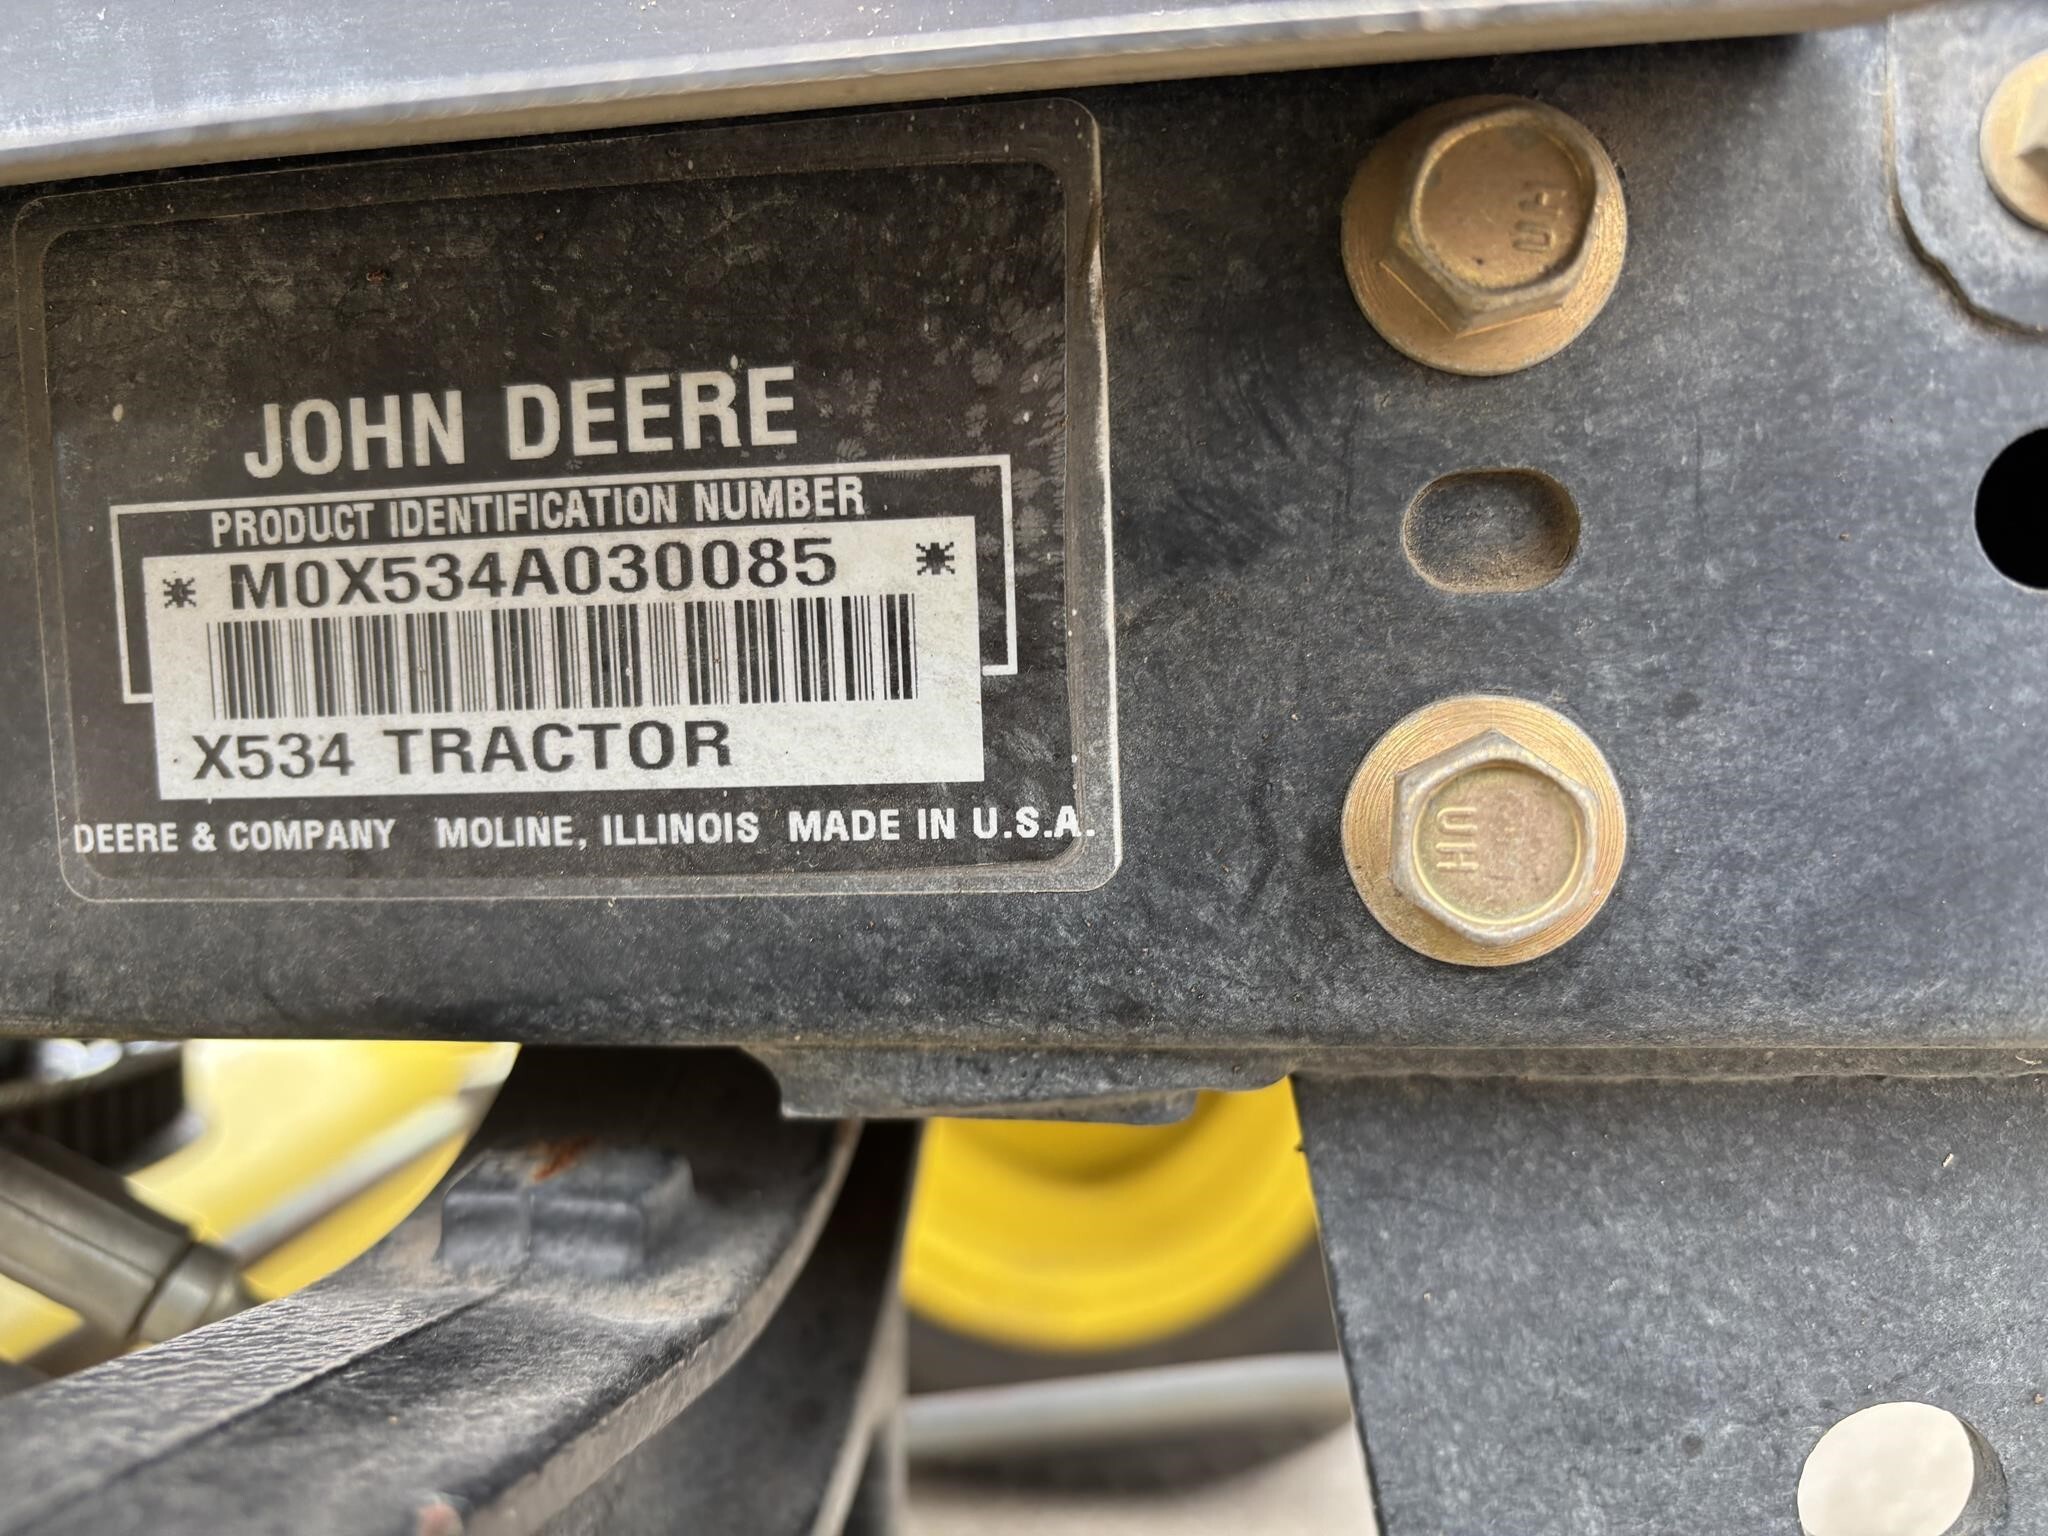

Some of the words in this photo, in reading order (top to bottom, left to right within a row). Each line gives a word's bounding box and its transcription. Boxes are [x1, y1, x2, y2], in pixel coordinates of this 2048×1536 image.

[244, 390, 466, 479] JOHN
[506, 366, 798, 461] DEERE
[211, 502, 374, 548] PRODUCT
[389, 484, 677, 538] IDENTIFICATION
[694, 475, 866, 523] NUMBER
[229, 537, 837, 610] M0X534A030085
[192, 731, 355, 780] X534
[383, 719, 731, 775] TRACTOR
[74, 822, 178, 854] DEERE
[192, 820, 217, 852] &
[229, 818, 397, 851] COMPANY
[434, 815, 588, 851] MOLINE,
[603, 811, 760, 846] ILLINOIS
[788, 808, 900, 843] MADE
[917, 807, 956, 840] IN
[972, 805, 1096, 840] U.S.A.
